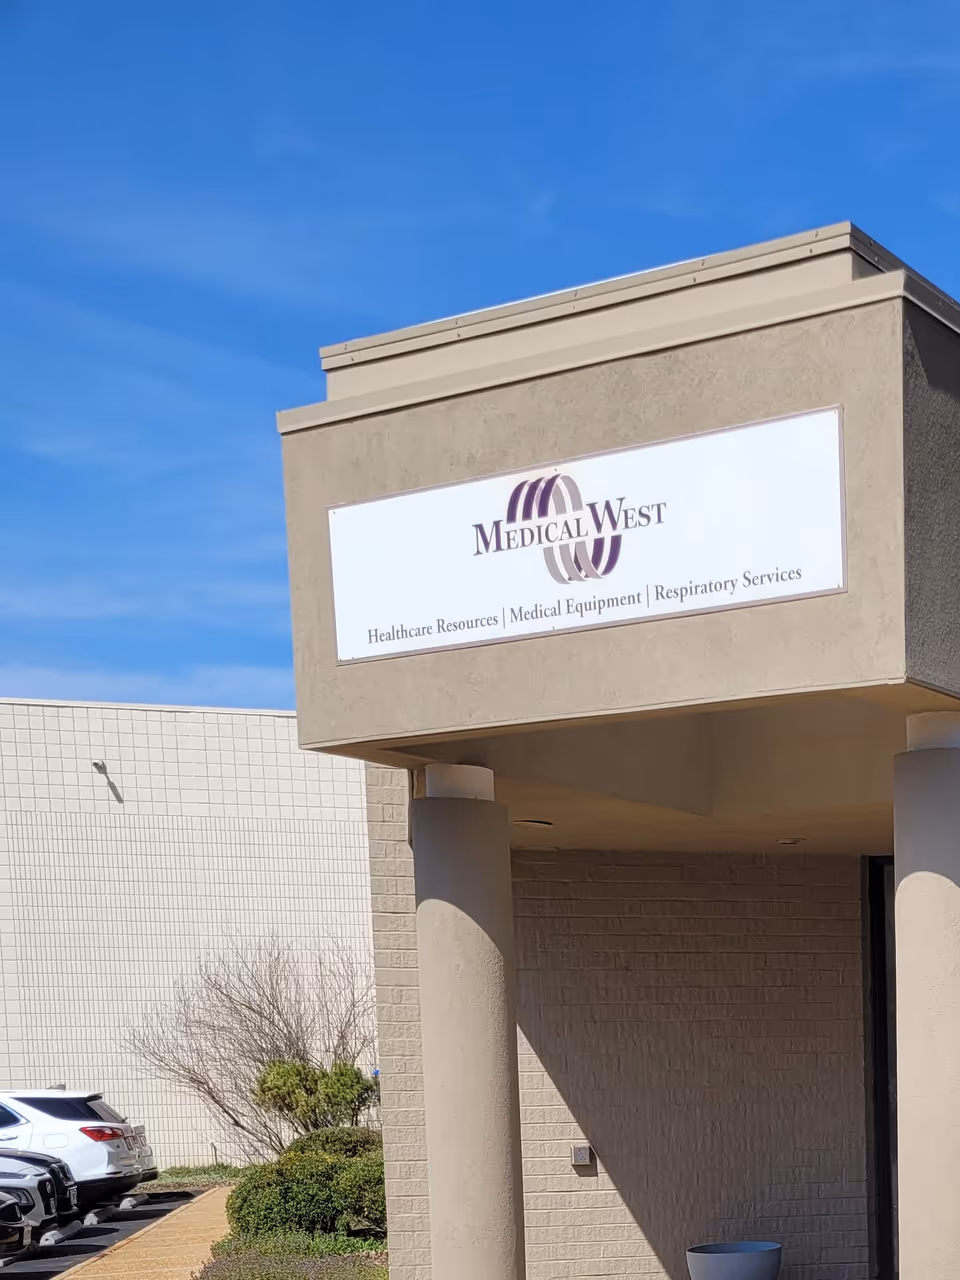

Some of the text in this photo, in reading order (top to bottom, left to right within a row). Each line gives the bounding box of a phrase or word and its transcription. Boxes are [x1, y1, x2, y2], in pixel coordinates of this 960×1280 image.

[368, 566, 802, 645] Healthcare Resources Medical Equipment Respiratory Services
